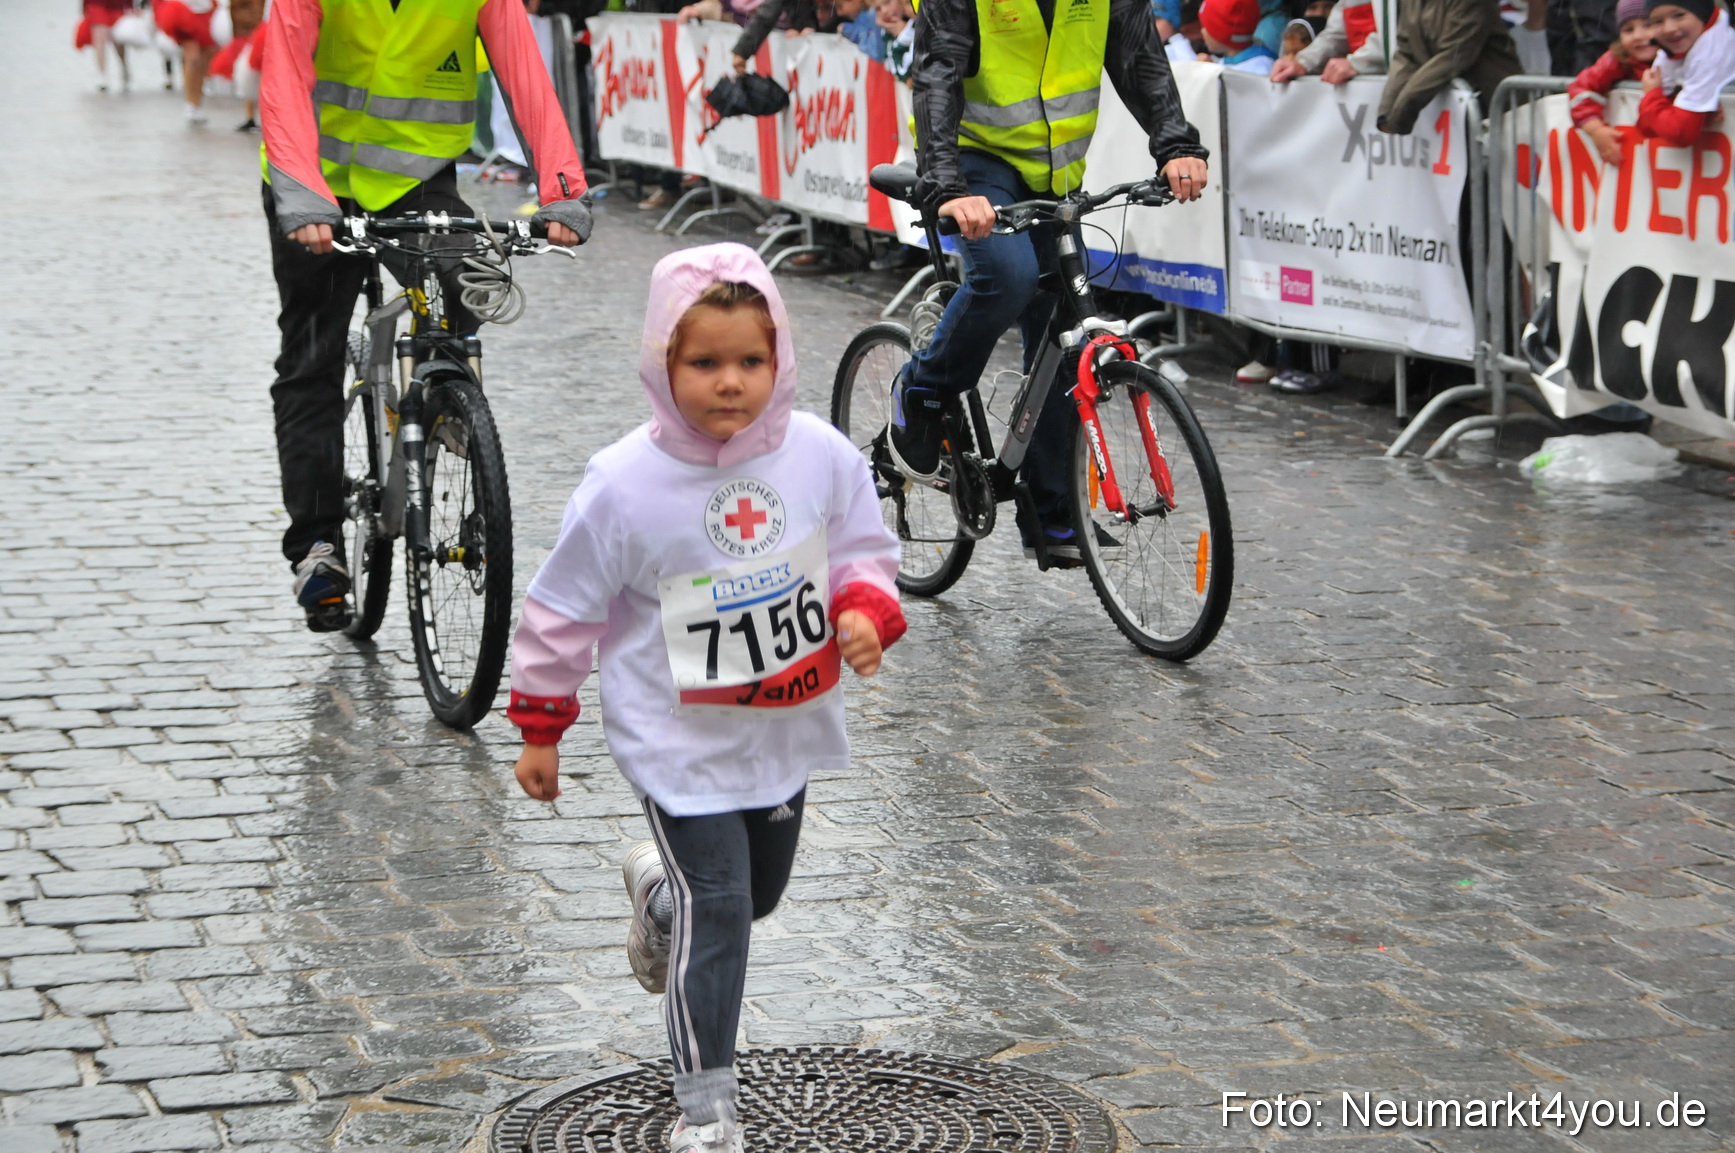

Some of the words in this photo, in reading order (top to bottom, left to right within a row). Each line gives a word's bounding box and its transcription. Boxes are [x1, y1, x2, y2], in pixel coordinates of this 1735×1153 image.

[1239, 207, 1256, 238] Ihr
[1257, 210, 1344, 259] Telekom-Shop
[1348, 221, 1366, 253] 2x
[1369, 222, 1384, 255] in
[710, 481, 779, 514] DEUTSCHES
[710, 523, 746, 556] ROTES
[750, 517, 782, 555] KREUZ
[712, 561, 791, 601] BOCK
[686, 581, 827, 682] 7156
[735, 666, 820, 705] Jana
